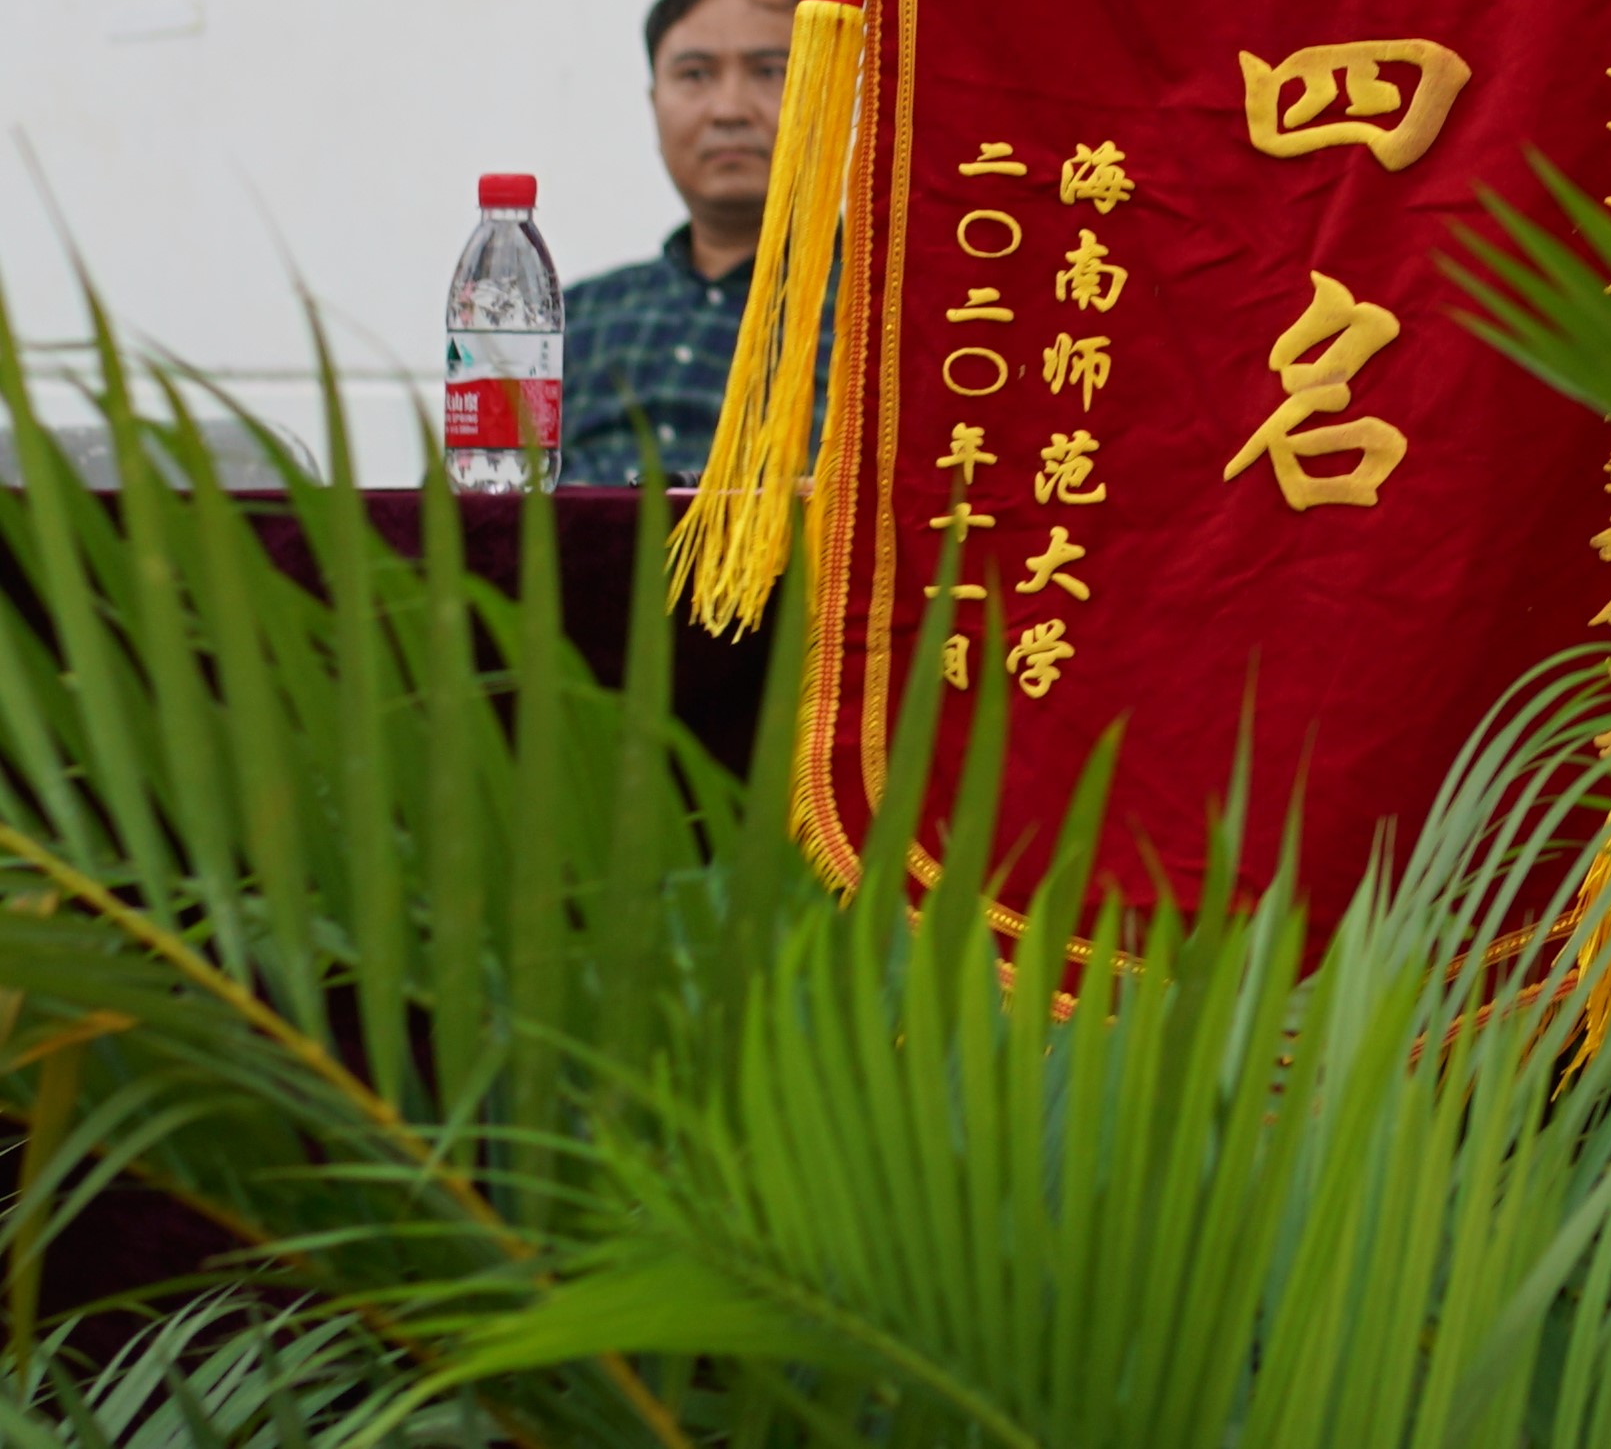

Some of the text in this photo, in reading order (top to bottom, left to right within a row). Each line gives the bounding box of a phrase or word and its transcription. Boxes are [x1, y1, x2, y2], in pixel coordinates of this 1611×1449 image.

[1006, 140, 1135, 699] 海南师范大学
